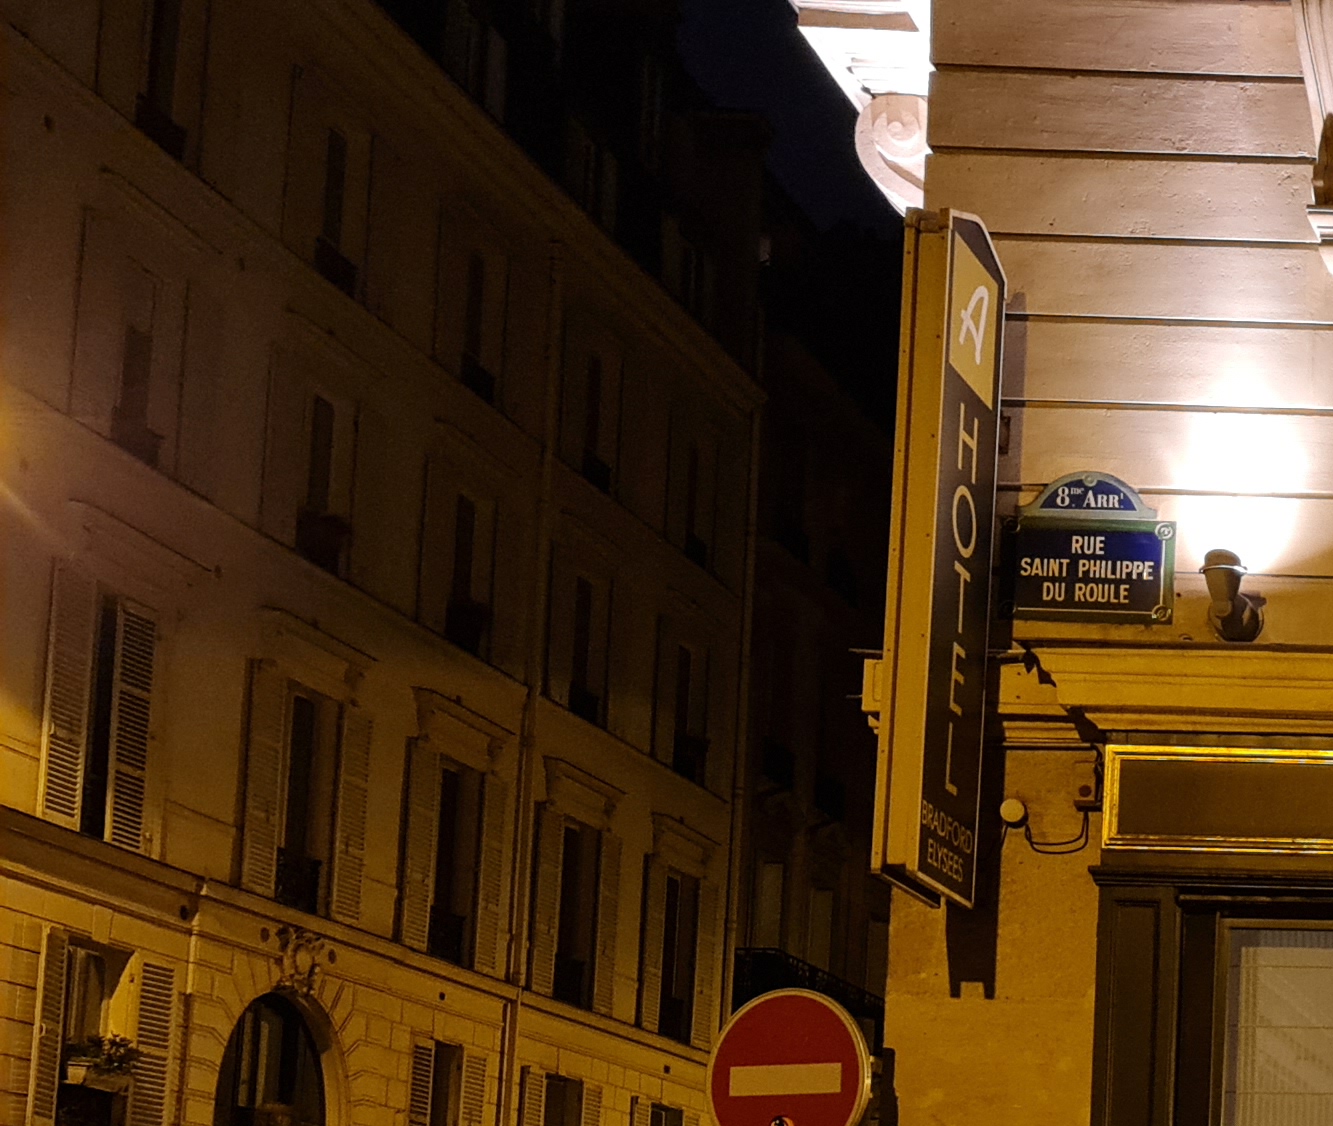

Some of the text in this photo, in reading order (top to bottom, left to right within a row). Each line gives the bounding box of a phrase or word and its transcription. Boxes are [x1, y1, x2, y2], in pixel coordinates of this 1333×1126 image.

[1071, 535, 1106, 555] RUE
[1019, 557, 1155, 581] SAINT PHILIPPE
[945, 402, 979, 797] HOTEL
[1042, 581, 1130, 604] DU ROULE
[921, 799, 974, 854] BRADFORD
